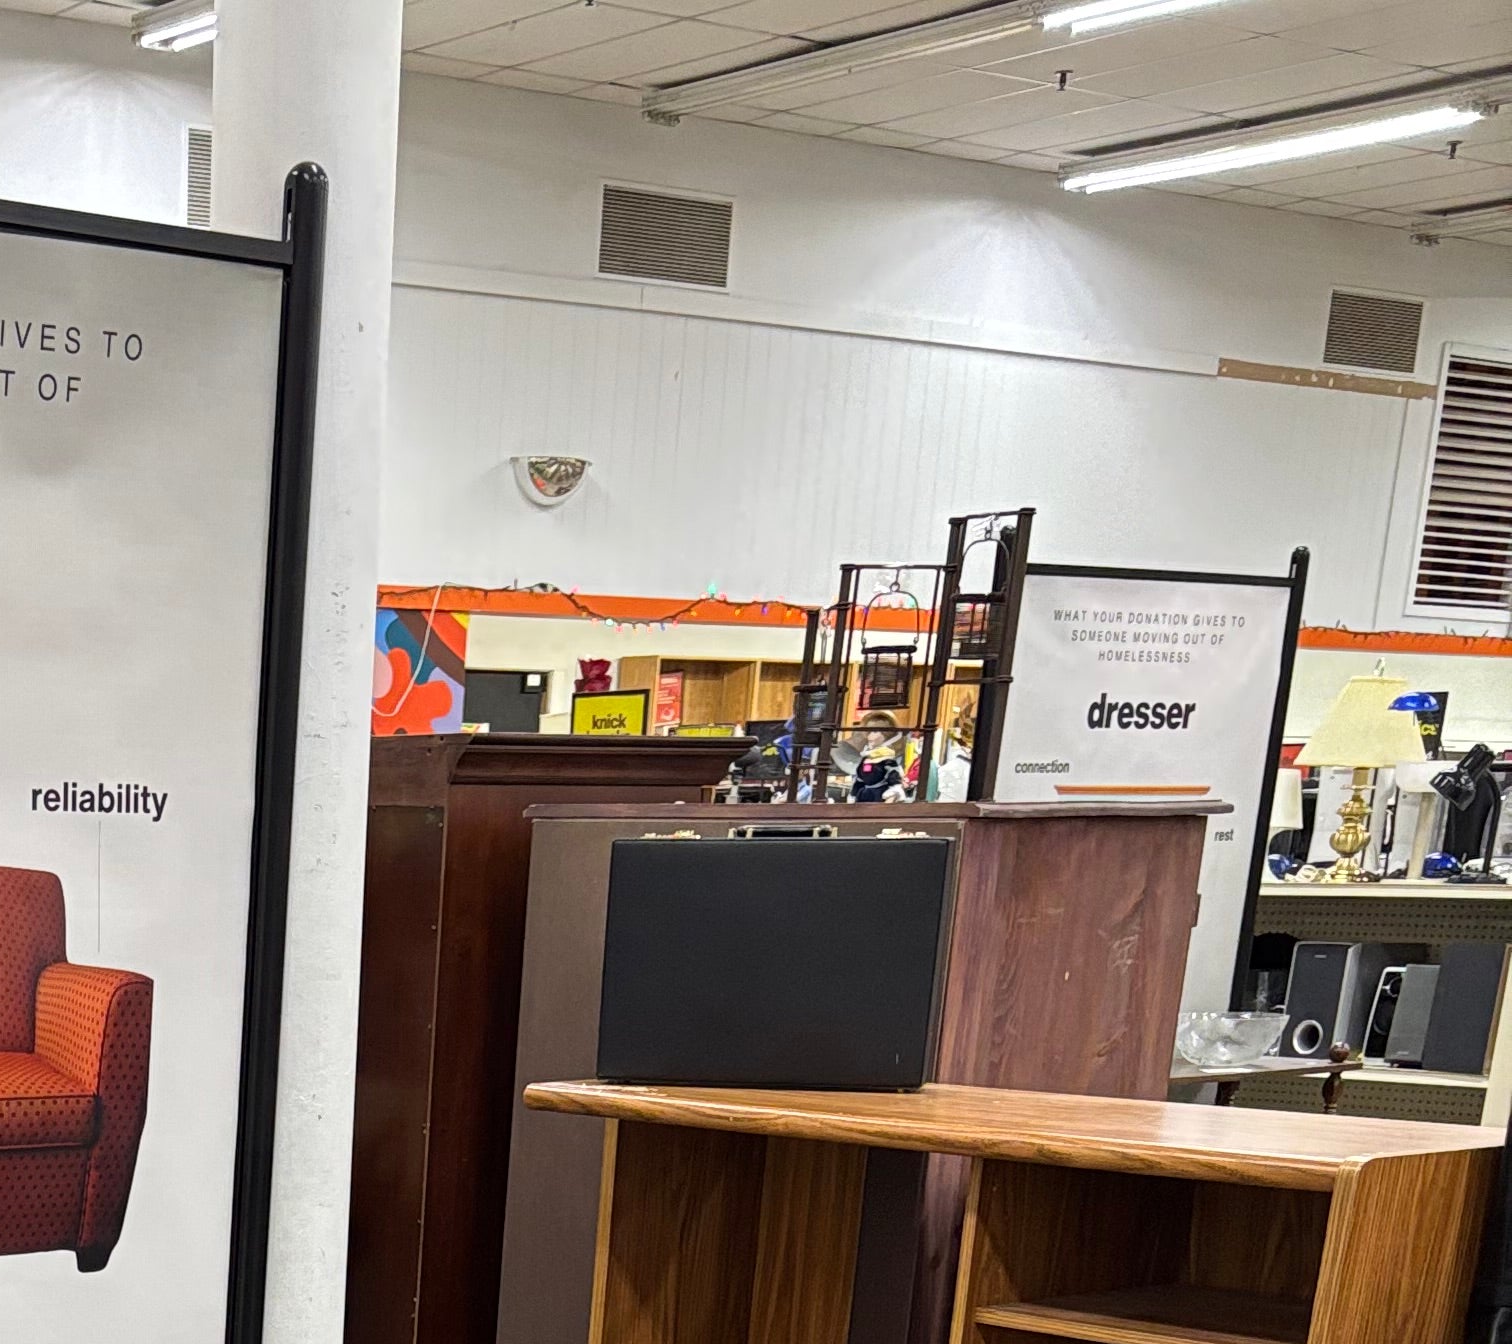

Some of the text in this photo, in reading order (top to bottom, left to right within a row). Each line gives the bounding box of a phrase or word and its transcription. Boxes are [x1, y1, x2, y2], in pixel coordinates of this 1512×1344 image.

[102, 331, 145, 362] TO
[38, 374, 83, 402] OF
[1053, 609, 1246, 628] WHAT YOUR DONATION GIVES TO
[1071, 630, 1225, 645] SOMEONE MOVING OUT OF
[1088, 693, 1196, 730] dresser
[591, 713, 627, 730] knick
[1014, 759, 1070, 773] connection
[30, 782, 168, 822] reliability
[1214, 829, 1234, 842] rest
